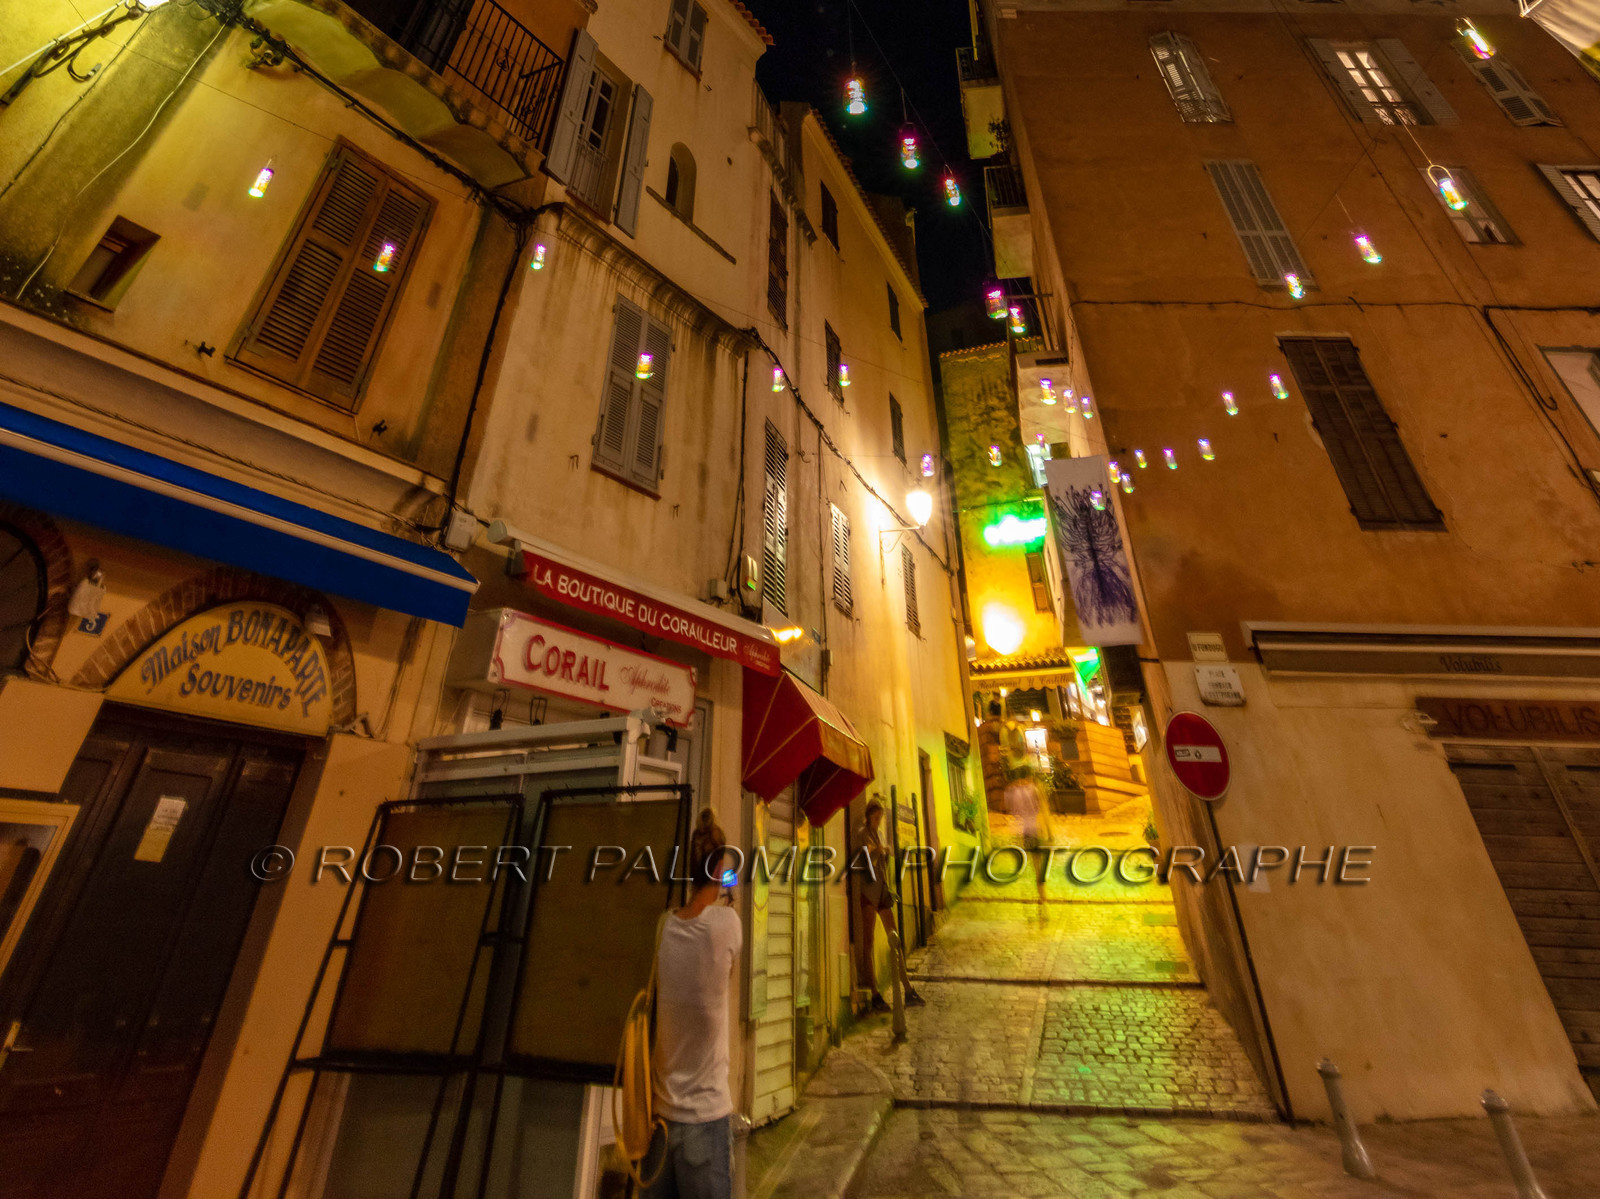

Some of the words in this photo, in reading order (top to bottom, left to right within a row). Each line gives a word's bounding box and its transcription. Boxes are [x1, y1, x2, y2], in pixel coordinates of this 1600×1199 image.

[533, 564, 553, 589] LA
[557, 575, 635, 618] BOUTIQUE
[638, 605, 656, 626] DU
[660, 613, 738, 655] CORAILLEUR
[141, 624, 222, 694] Maison
[223, 610, 327, 718] BONAPARTE
[178, 663, 293, 709] Souvenirs
[523, 634, 610, 691] CORAIL
[1440, 655, 1505, 672] Volubilis
[1442, 704, 1600, 736] VOLUBILIS
